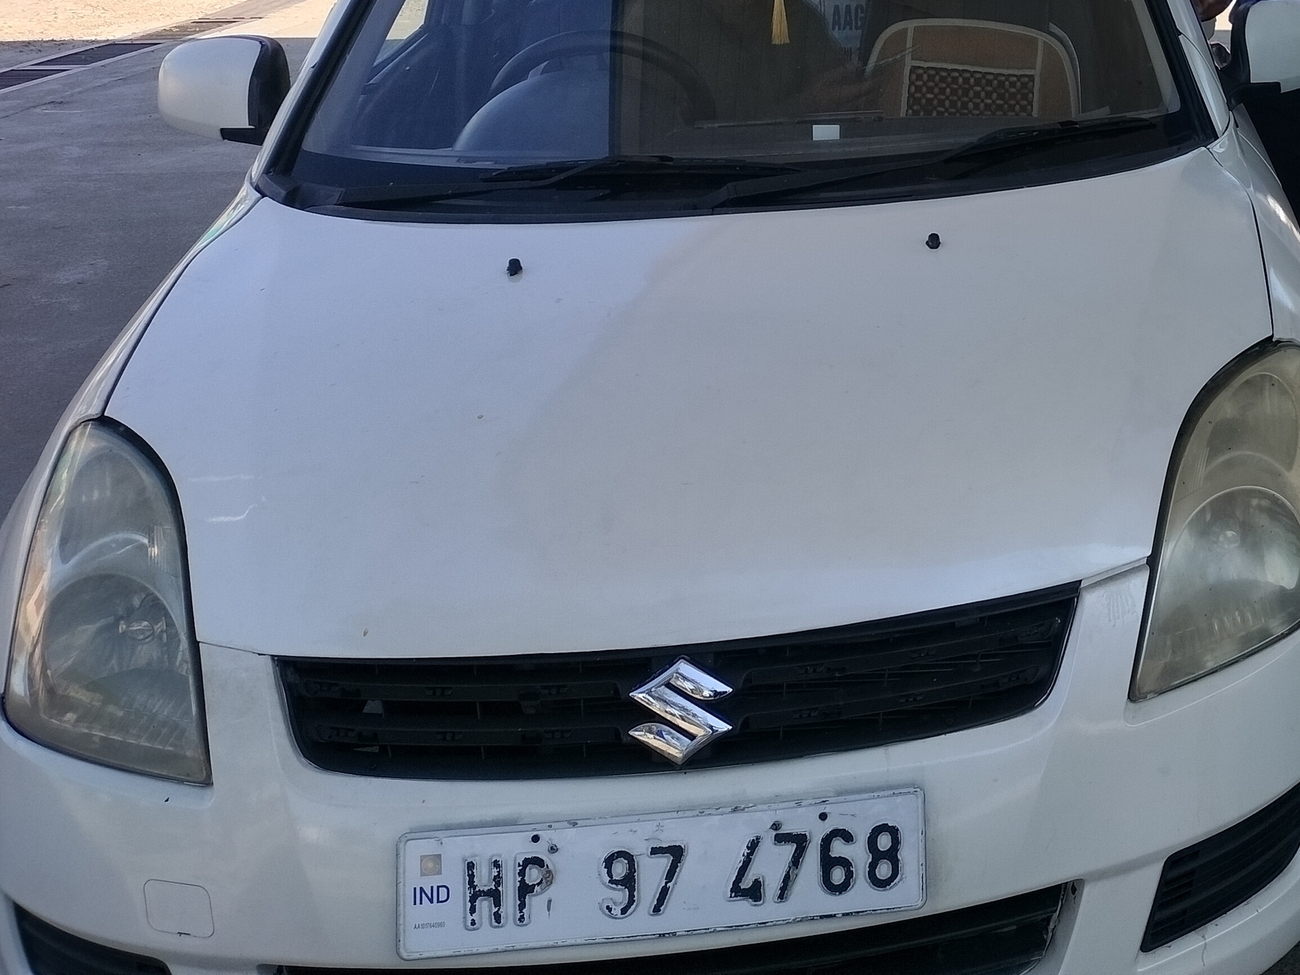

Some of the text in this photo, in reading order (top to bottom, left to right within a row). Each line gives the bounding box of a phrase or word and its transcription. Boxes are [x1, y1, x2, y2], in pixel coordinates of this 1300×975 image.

[413, 885, 450, 906] IND
[464, 822, 904, 929] HP 97 4768
